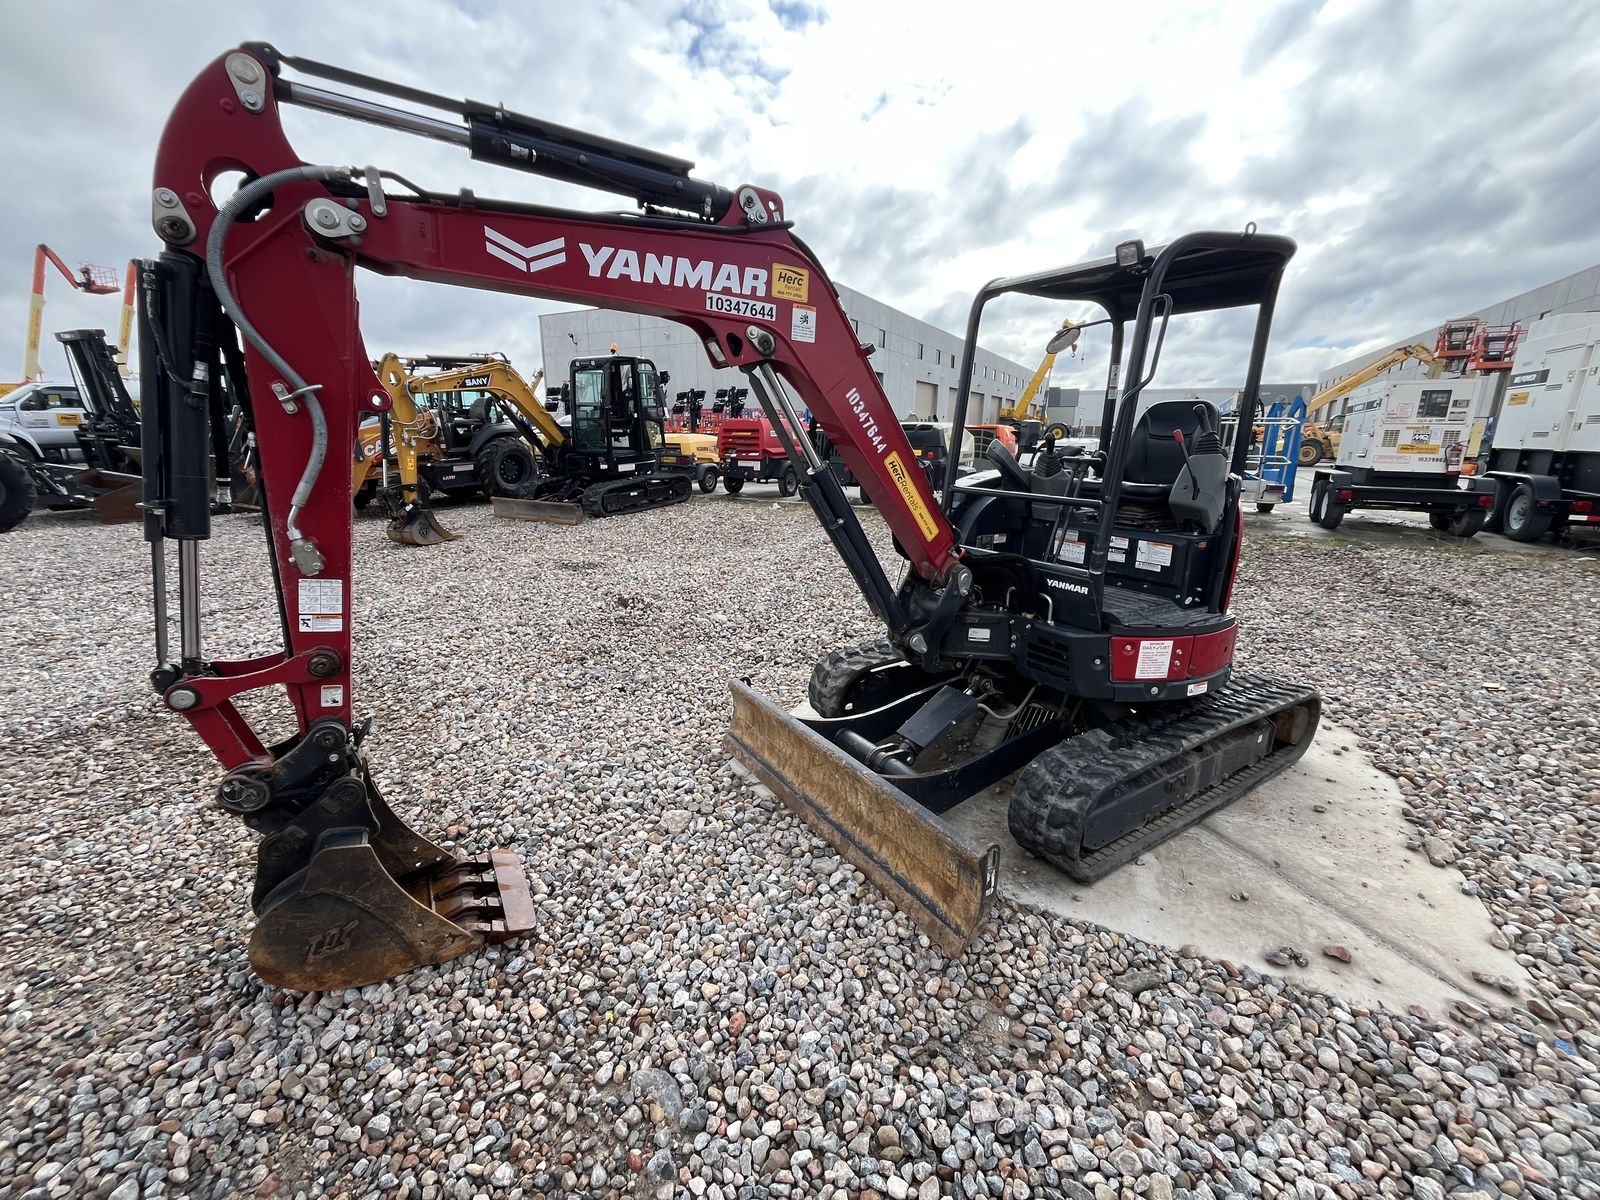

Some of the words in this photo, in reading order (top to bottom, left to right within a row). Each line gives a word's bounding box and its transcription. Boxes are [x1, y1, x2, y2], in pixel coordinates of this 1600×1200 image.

[578, 242, 769, 297] YANMAR
[778, 271, 804, 287] Herc
[706, 294, 775, 321] 10347644
[465, 377, 488, 387] SANY
[845, 387, 887, 454] 10347644
[1046, 579, 1089, 595] YANMAR
